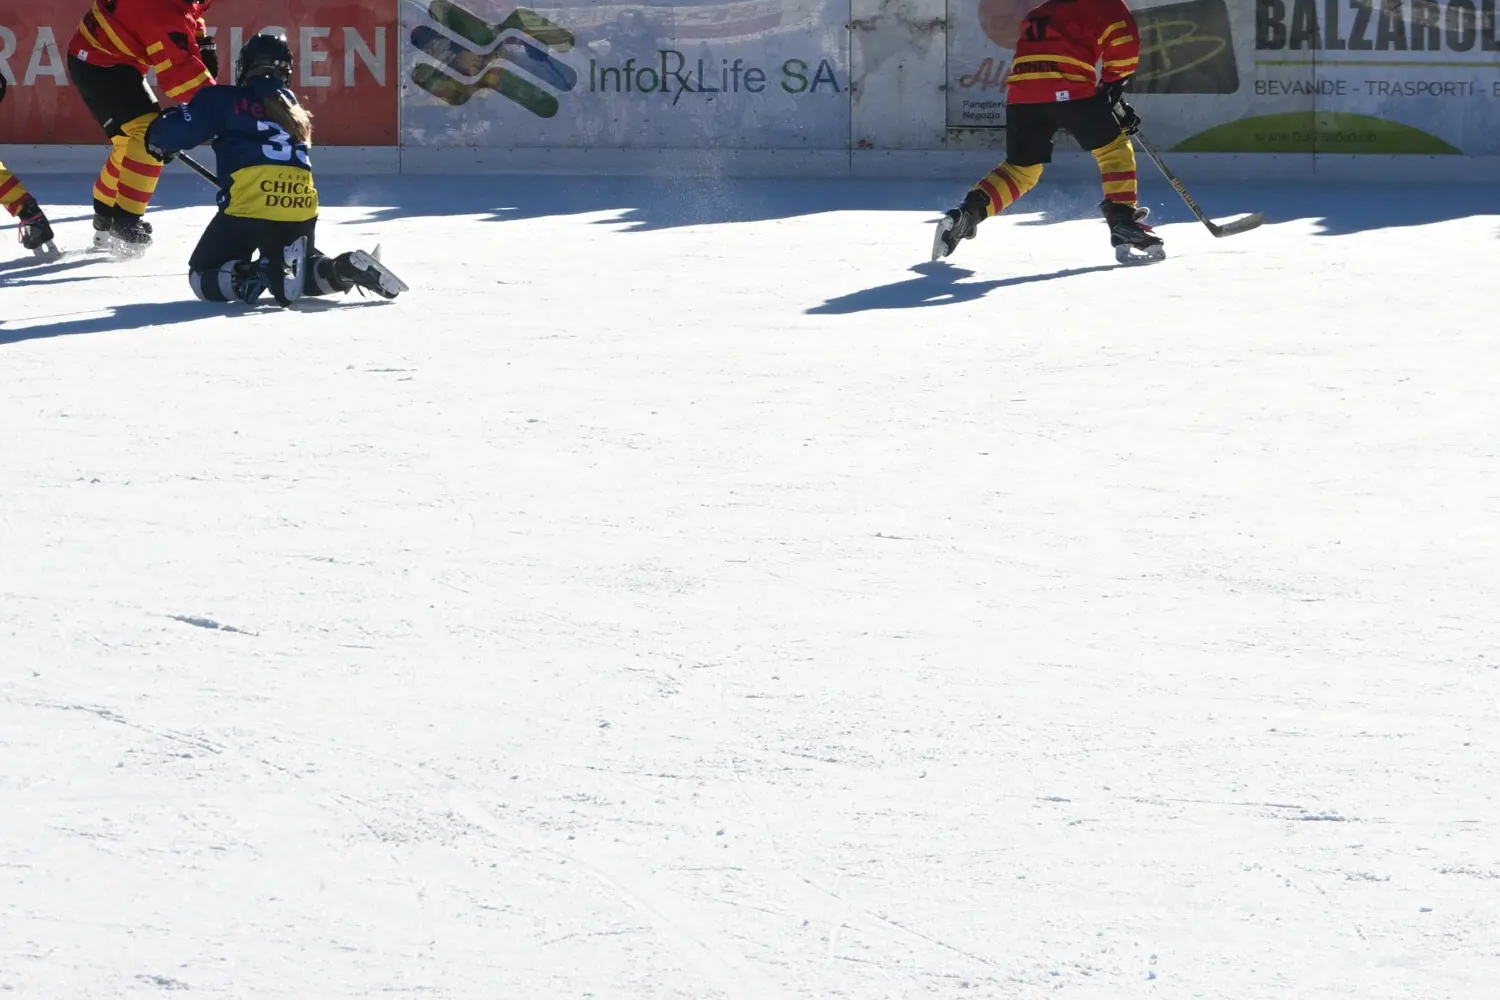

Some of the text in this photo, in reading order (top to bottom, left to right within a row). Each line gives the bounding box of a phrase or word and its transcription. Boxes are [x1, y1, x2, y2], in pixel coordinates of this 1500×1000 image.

[781, 57, 841, 94] SA
[1254, 80, 1347, 96] BEVANDE
[1365, 81, 1473, 97] TRASPORTI
[962, 111, 1001, 120] Negozio
